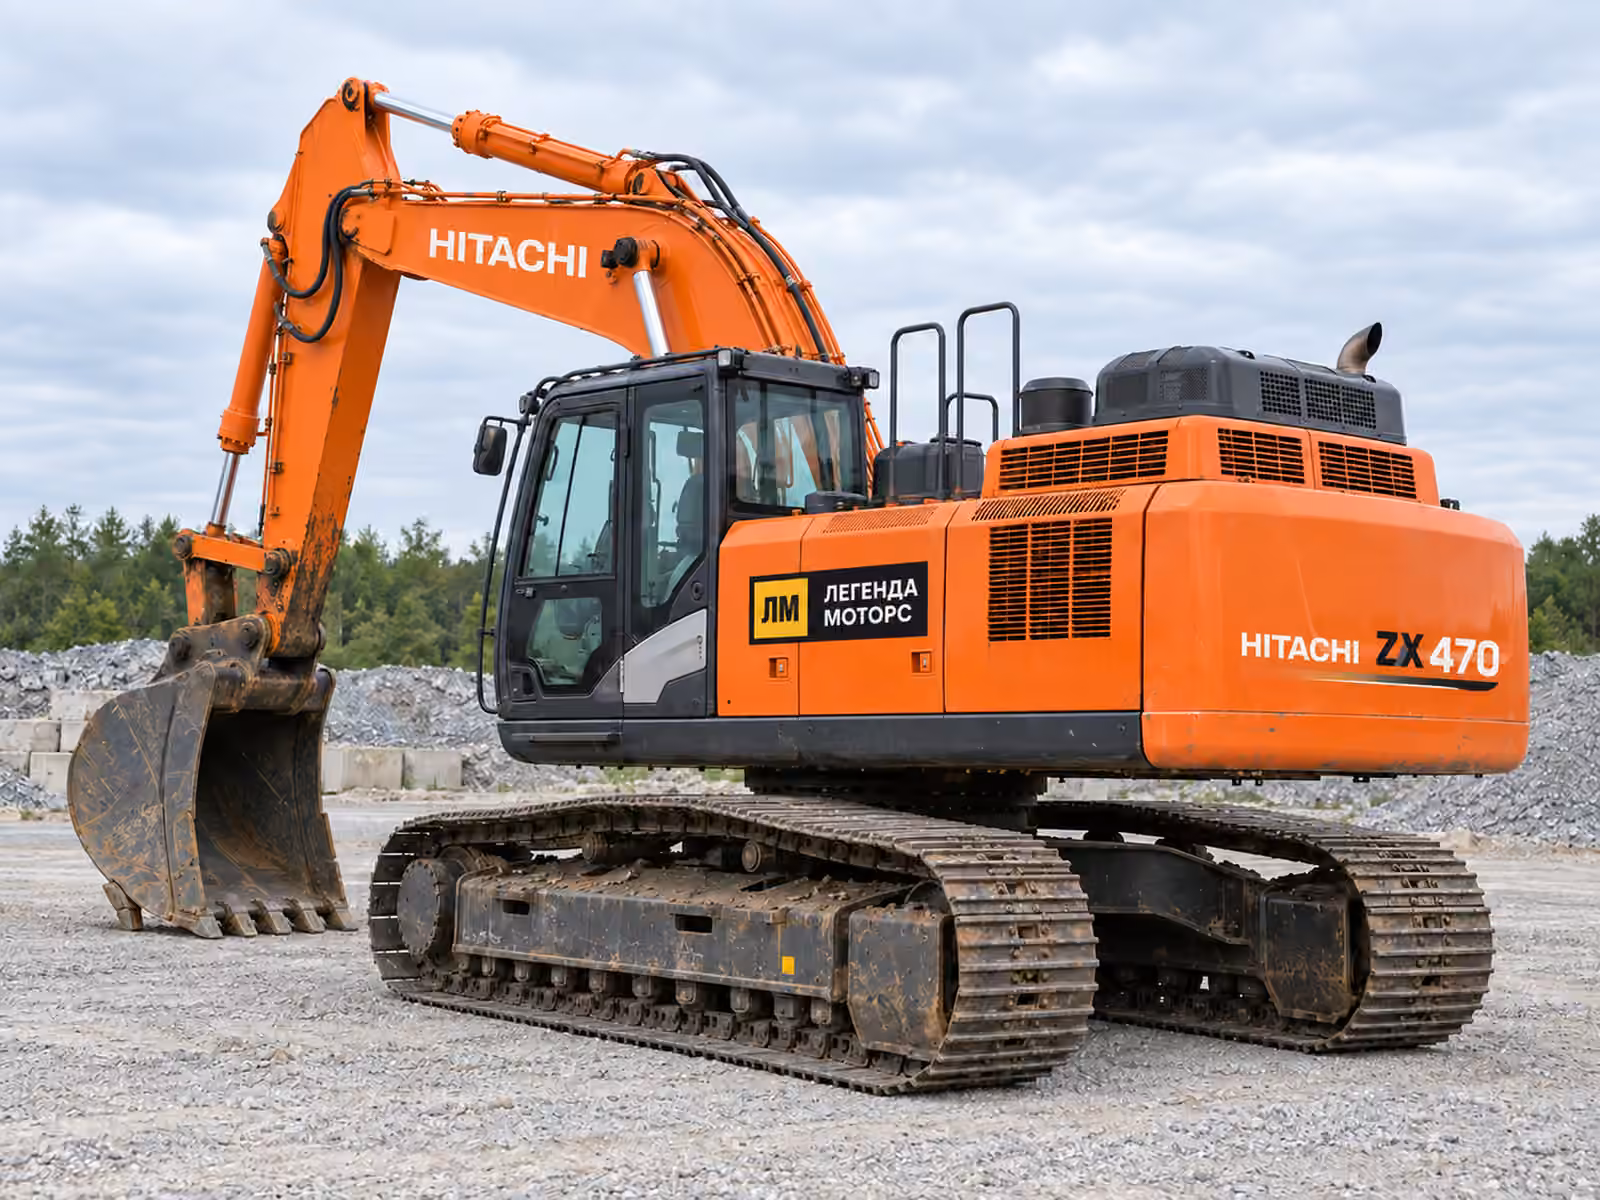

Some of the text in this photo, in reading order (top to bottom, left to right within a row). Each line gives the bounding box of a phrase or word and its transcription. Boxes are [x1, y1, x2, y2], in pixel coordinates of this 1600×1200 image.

[428, 228, 588, 278] HITACHI
[824, 578, 919, 603] ЛЕГЕНДА
[761, 594, 800, 624] ЛМ
[824, 604, 912, 627] МОТОРС
[1240, 630, 1500, 677] HITACHI ZX 470
